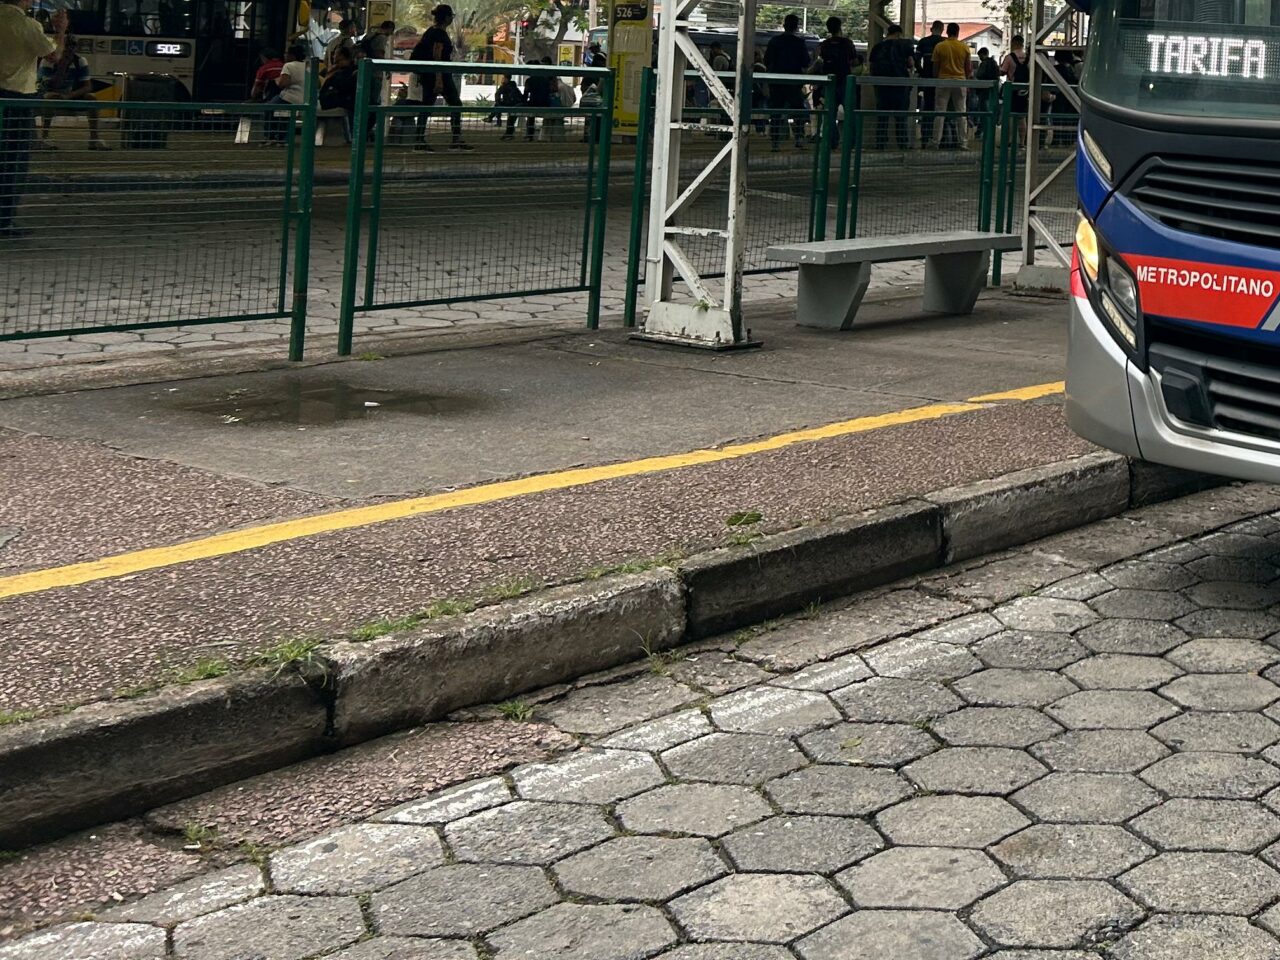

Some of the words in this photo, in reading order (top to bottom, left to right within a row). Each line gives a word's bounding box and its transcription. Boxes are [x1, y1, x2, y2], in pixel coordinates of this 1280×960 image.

[616, 7, 633, 18] 526
[156, 43, 181, 55] 502
[1147, 34, 1266, 79] TARIFA
[1136, 265, 1274, 298] METROPOLITANO
